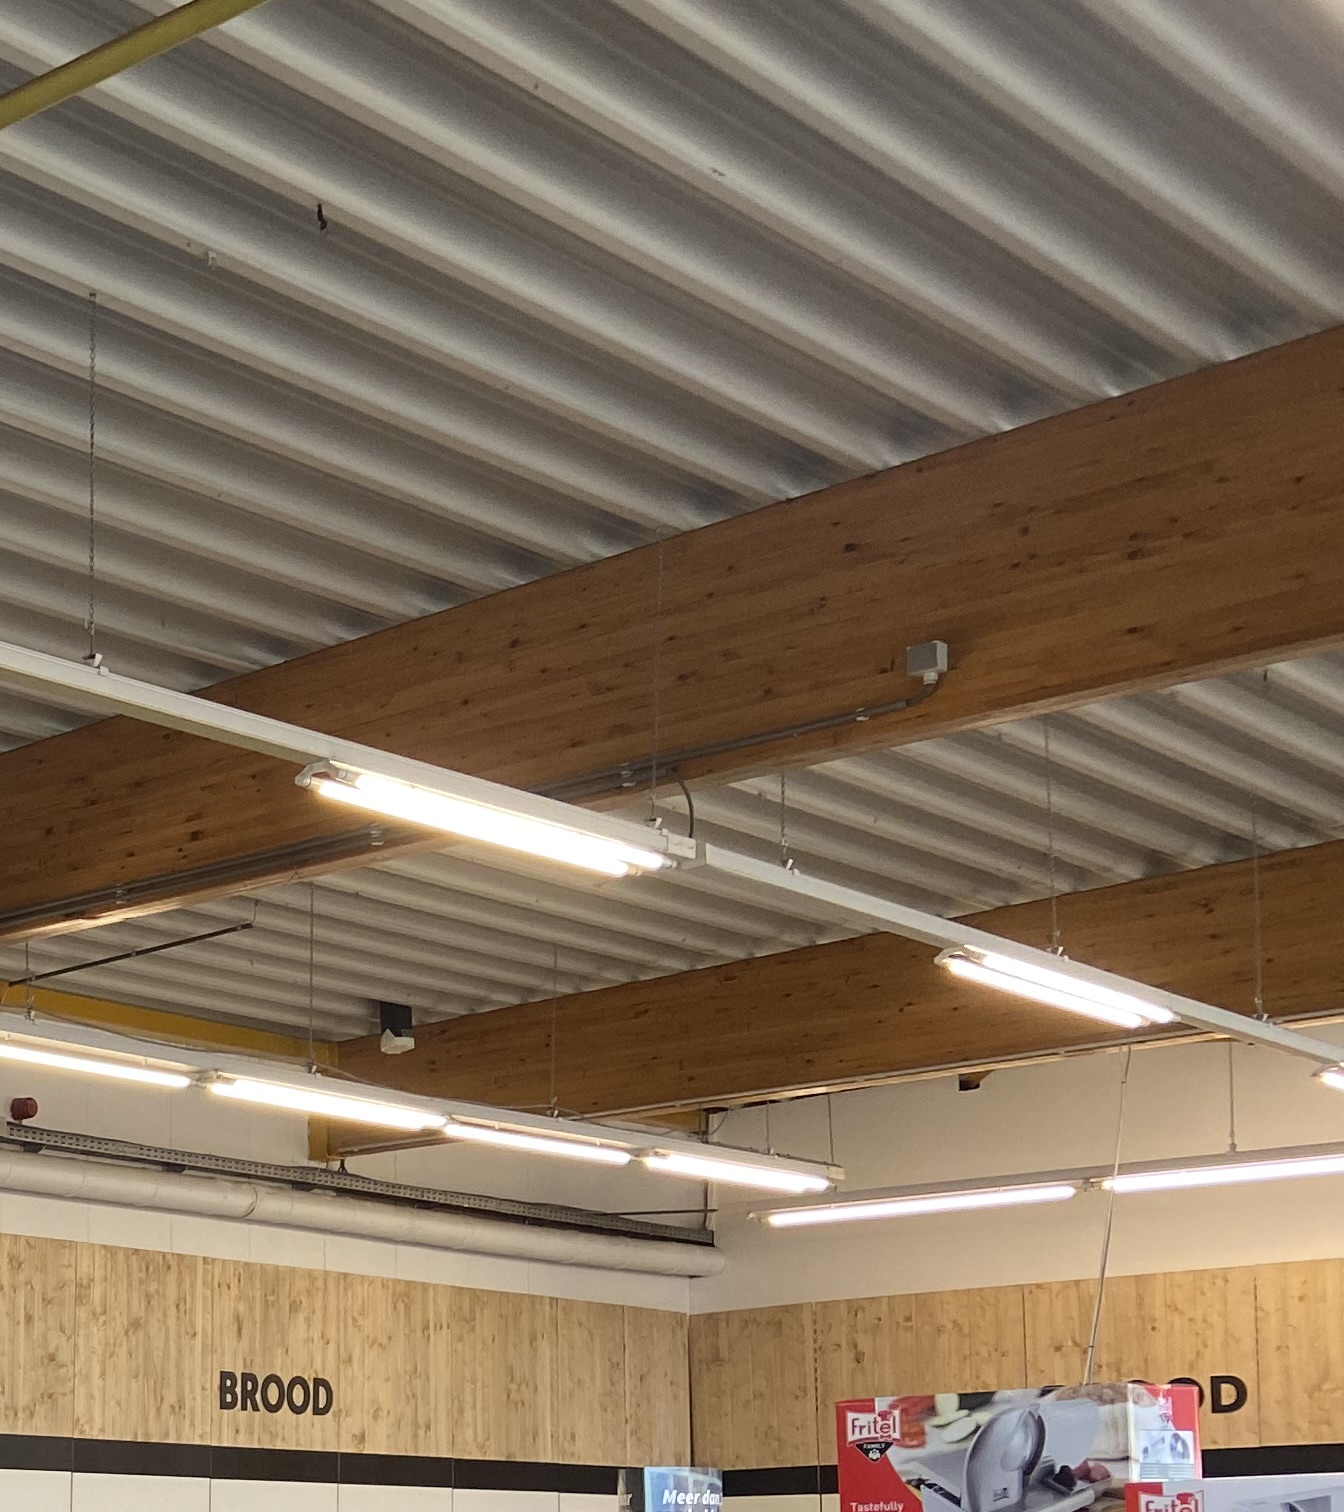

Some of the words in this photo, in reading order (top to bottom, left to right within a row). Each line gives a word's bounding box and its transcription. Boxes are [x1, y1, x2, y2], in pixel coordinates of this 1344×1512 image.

[219, 1370, 334, 1416] BROOD
[662, 1489, 701, 1506] Meer
[849, 1501, 904, 1512] Tastefully
